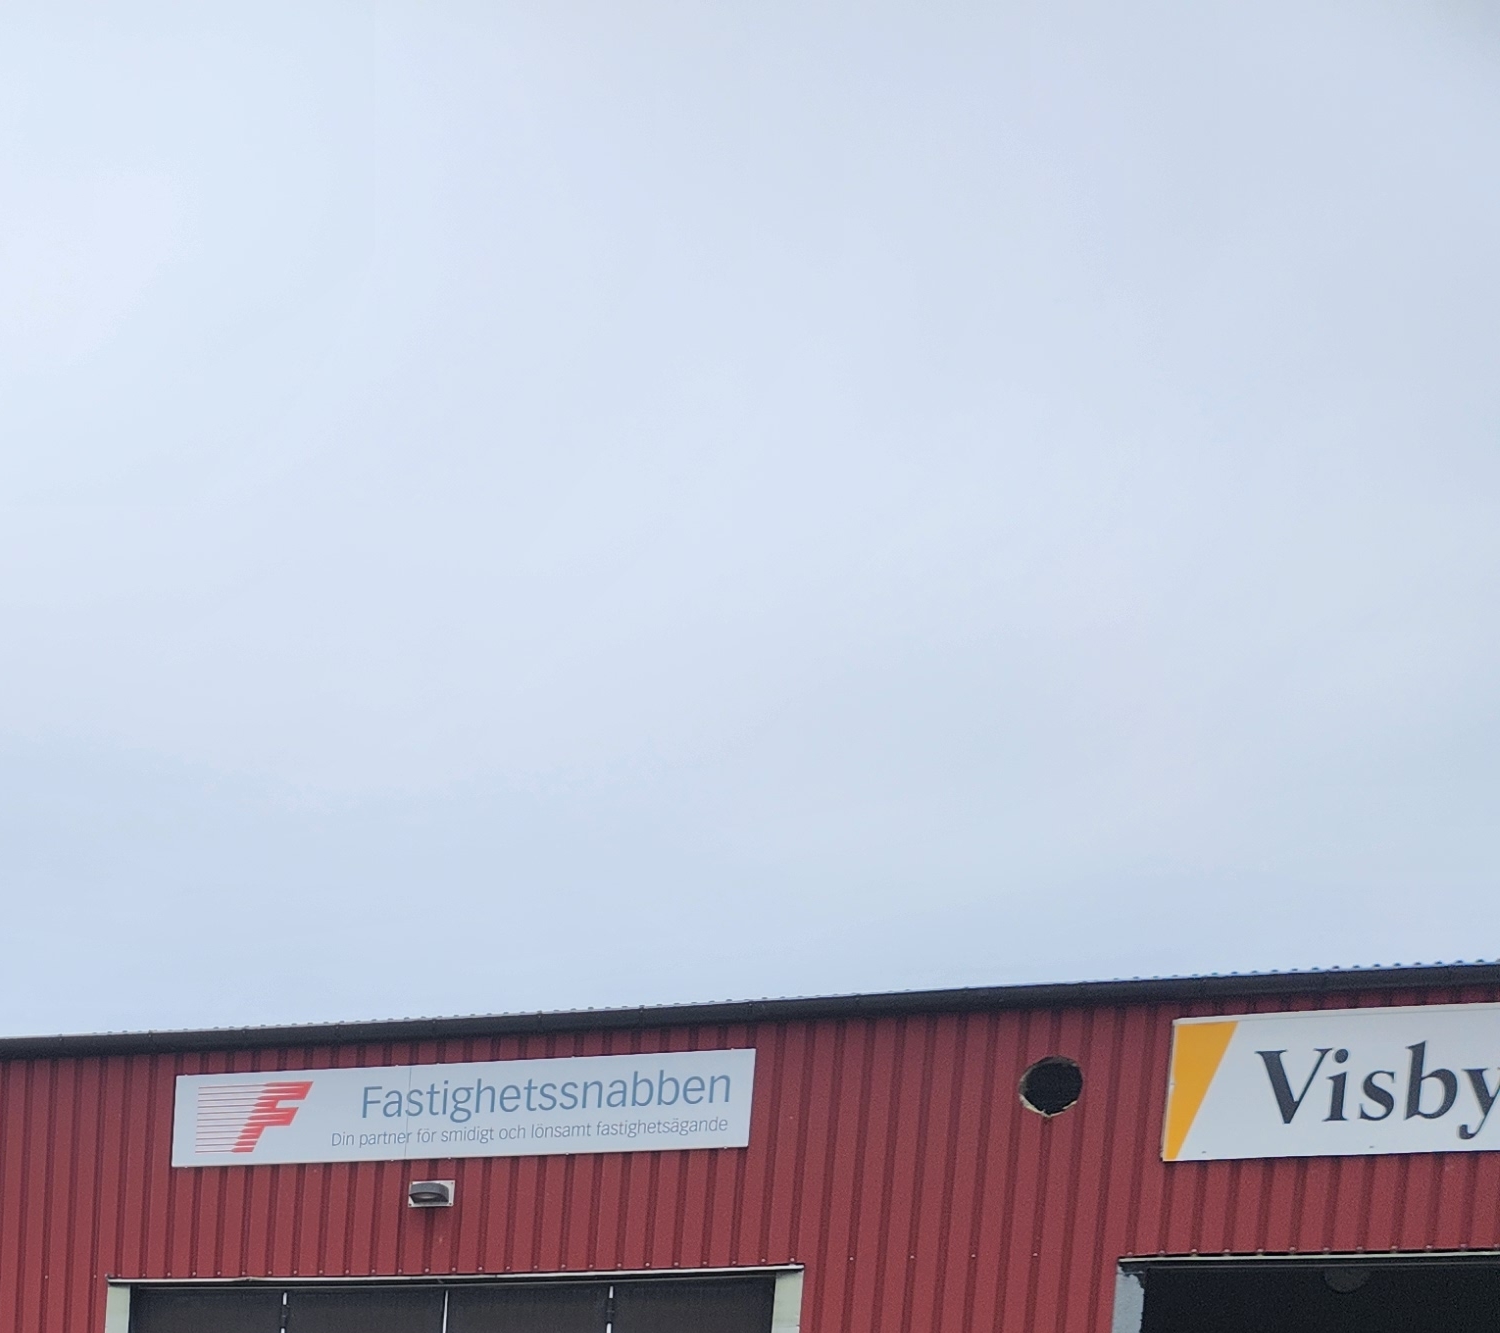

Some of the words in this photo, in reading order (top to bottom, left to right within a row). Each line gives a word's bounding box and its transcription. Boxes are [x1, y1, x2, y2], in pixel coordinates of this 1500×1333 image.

[361, 1069, 731, 1124] Fastighetssnabben
[1255, 1040, 1500, 1141] Visby
[331, 1131, 355, 1147] Din
[359, 1131, 412, 1149] partner
[416, 1127, 437, 1143] för
[440, 1125, 495, 1145] smidigt
[498, 1124, 526, 1140] och
[530, 1122, 592, 1139] lönsamt
[596, 1116, 728, 1138] fastighetsägande
